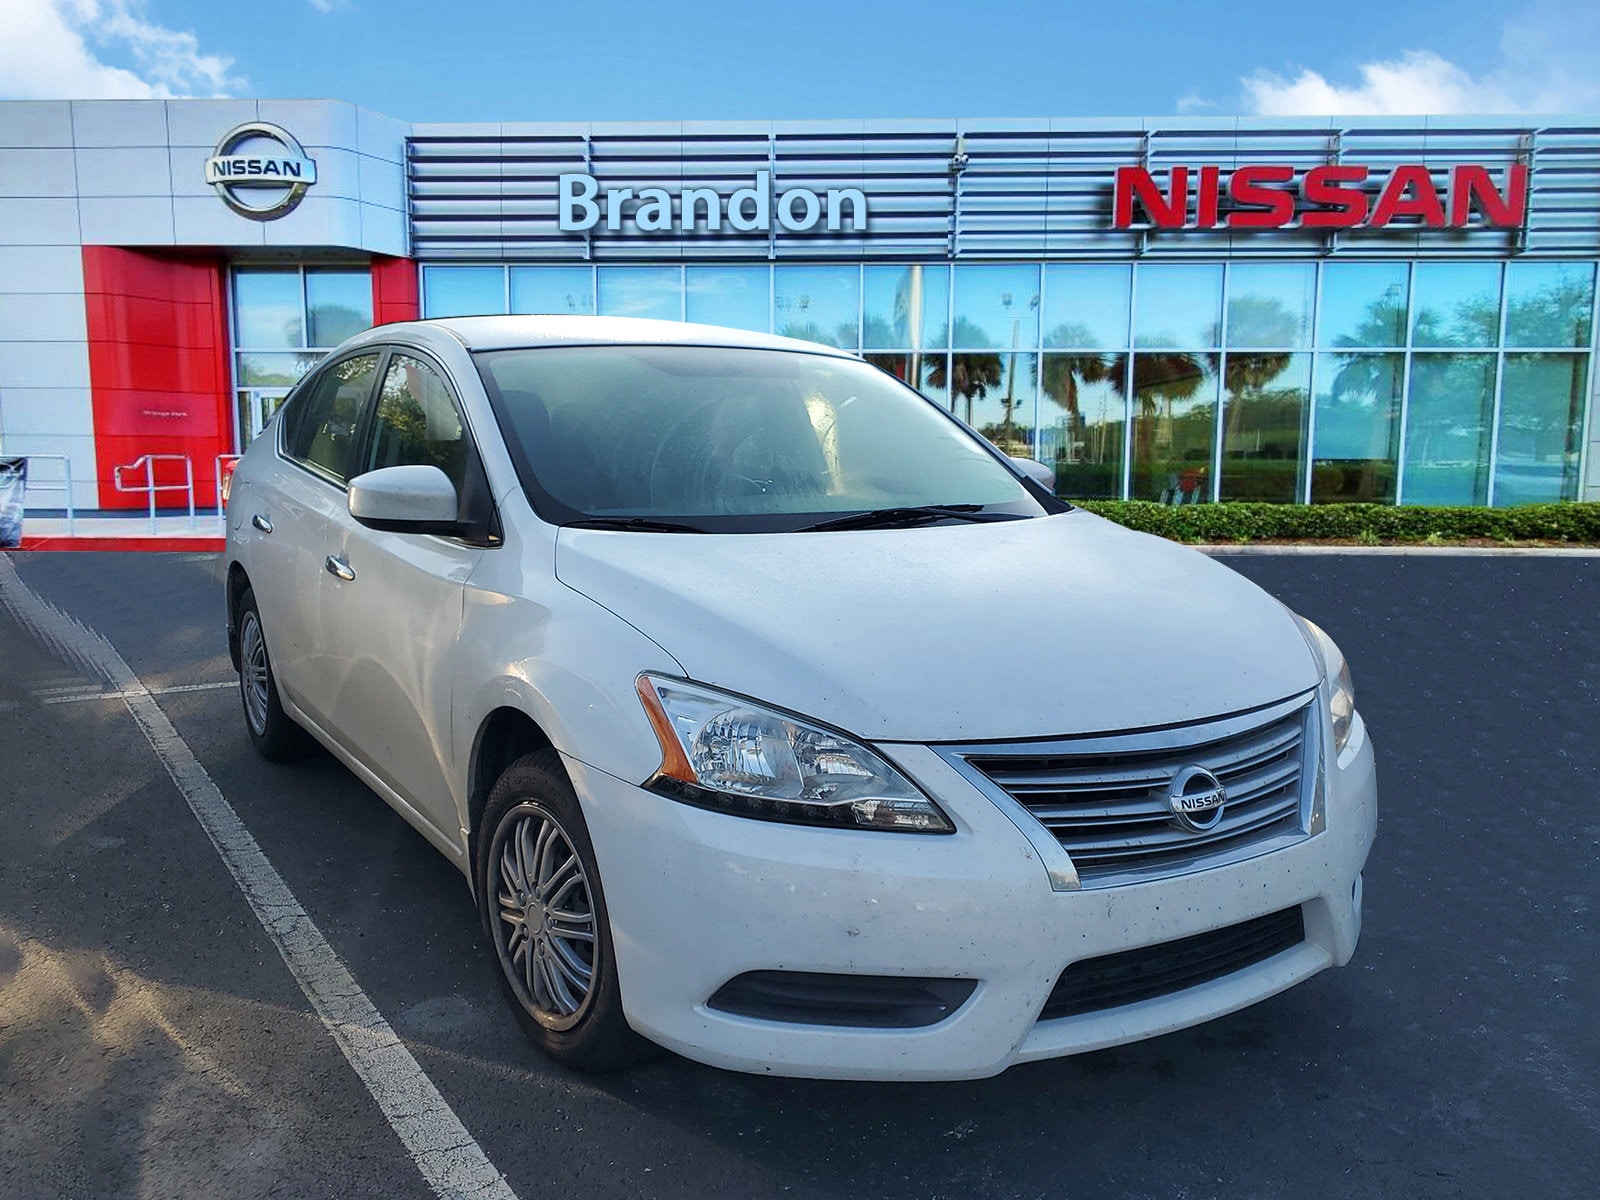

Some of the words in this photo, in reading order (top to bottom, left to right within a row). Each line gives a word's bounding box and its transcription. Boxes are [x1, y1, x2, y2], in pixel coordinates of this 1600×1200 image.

[213, 159, 301, 177] NISSAN
[559, 170, 867, 231] Brandon
[1113, 164, 1528, 229] NISSAN
[1181, 791, 1225, 809] NISSAN
